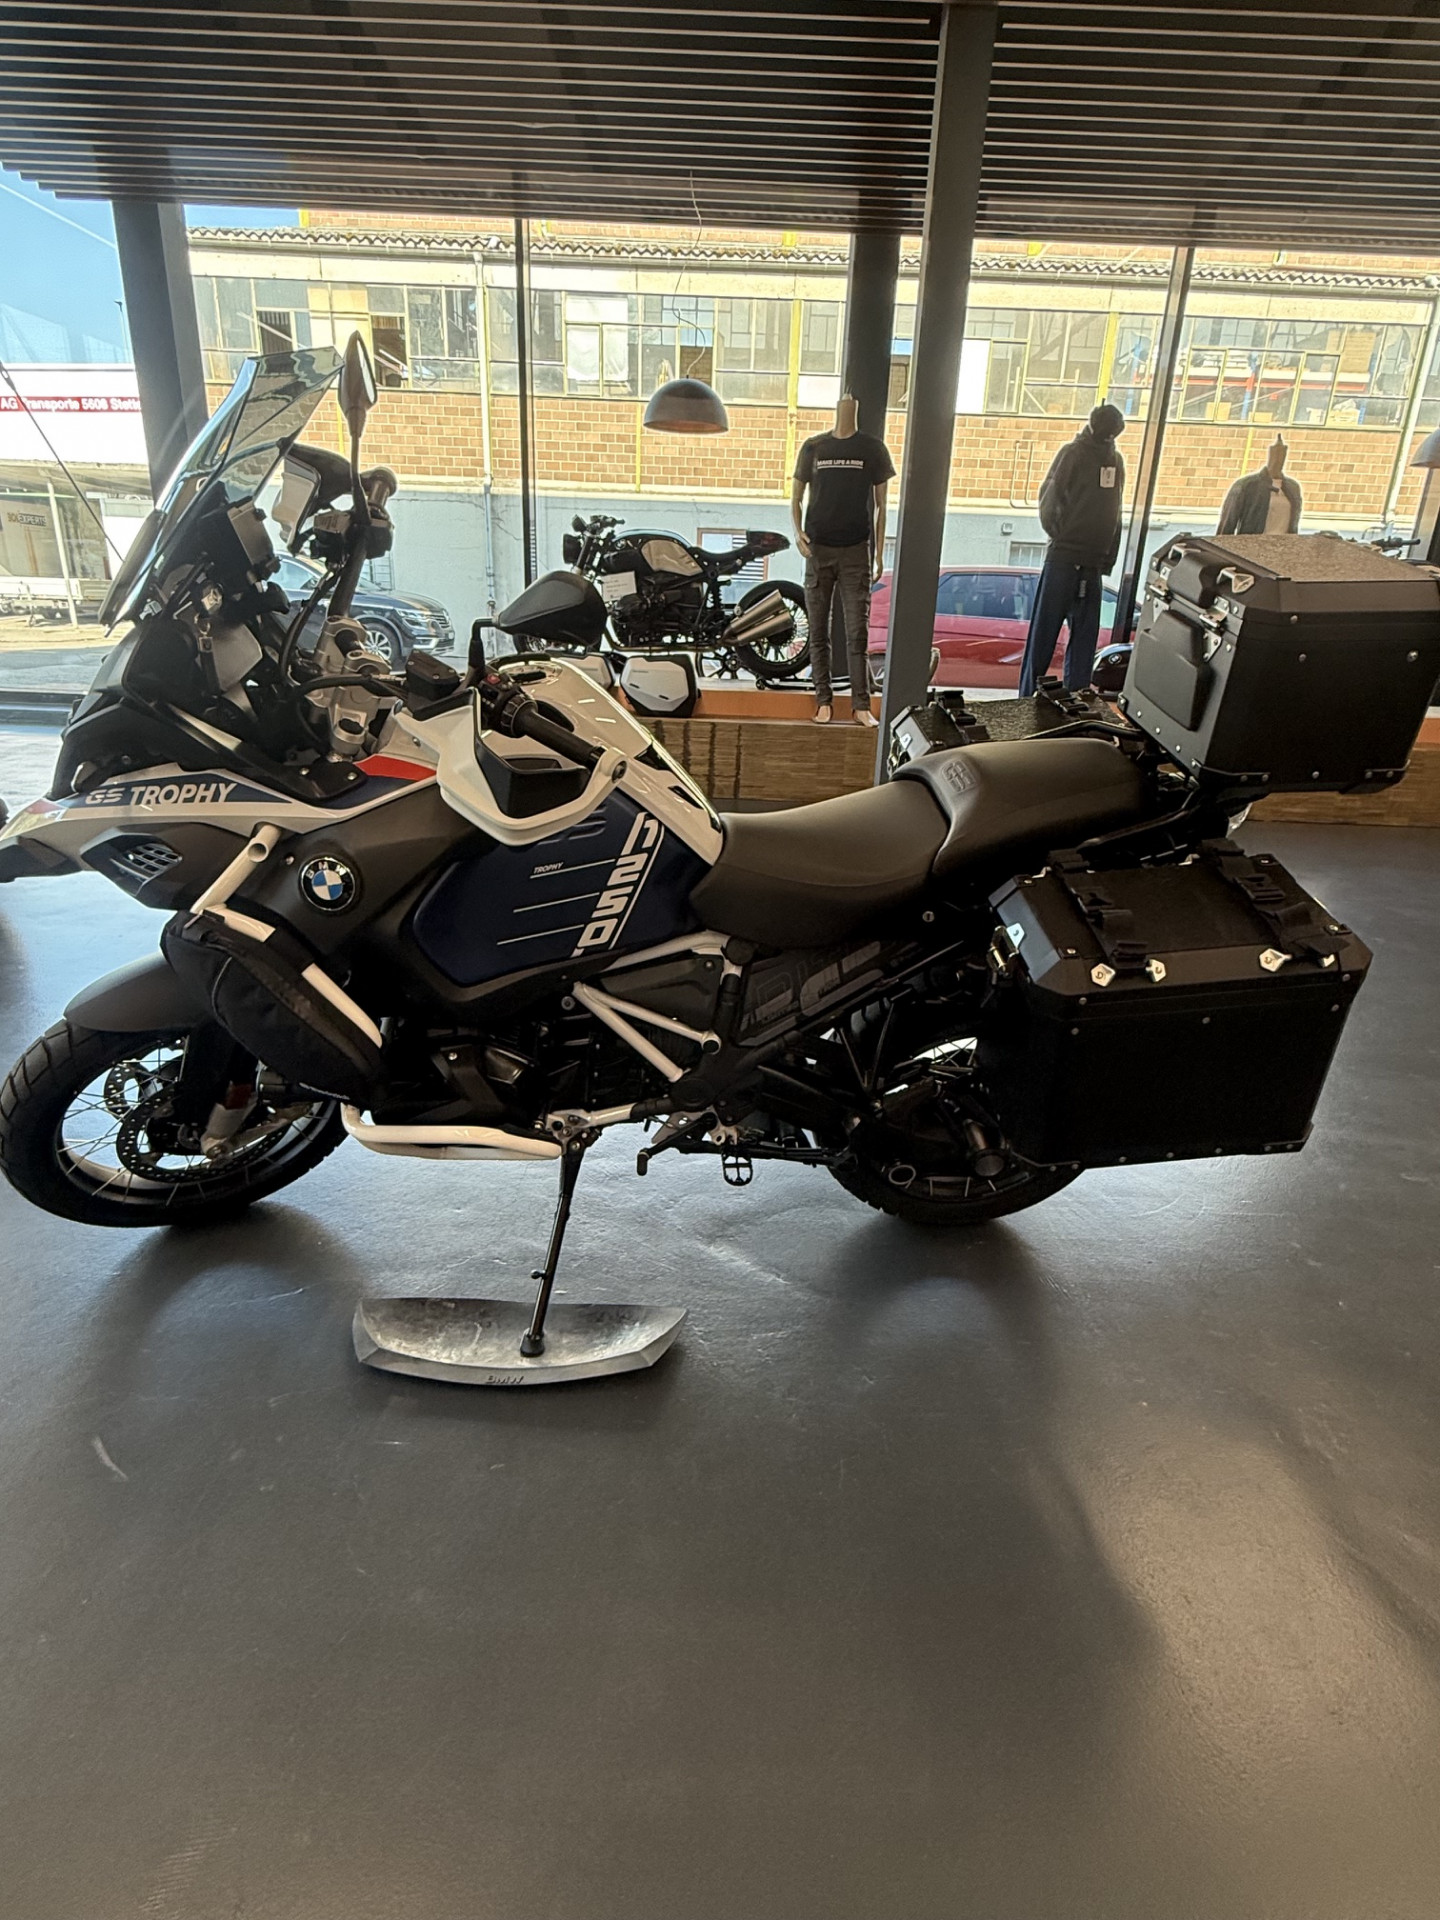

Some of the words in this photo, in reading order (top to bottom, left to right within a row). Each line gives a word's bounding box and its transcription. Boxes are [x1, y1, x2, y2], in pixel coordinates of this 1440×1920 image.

[0, 397, 18, 410] AG
[85, 787, 126, 805] GS
[130, 782, 238, 806] TROPHY
[305, 861, 347, 879] BMW
[533, 861, 564, 875] TROPHY
[577, 818, 660, 948] 1250
